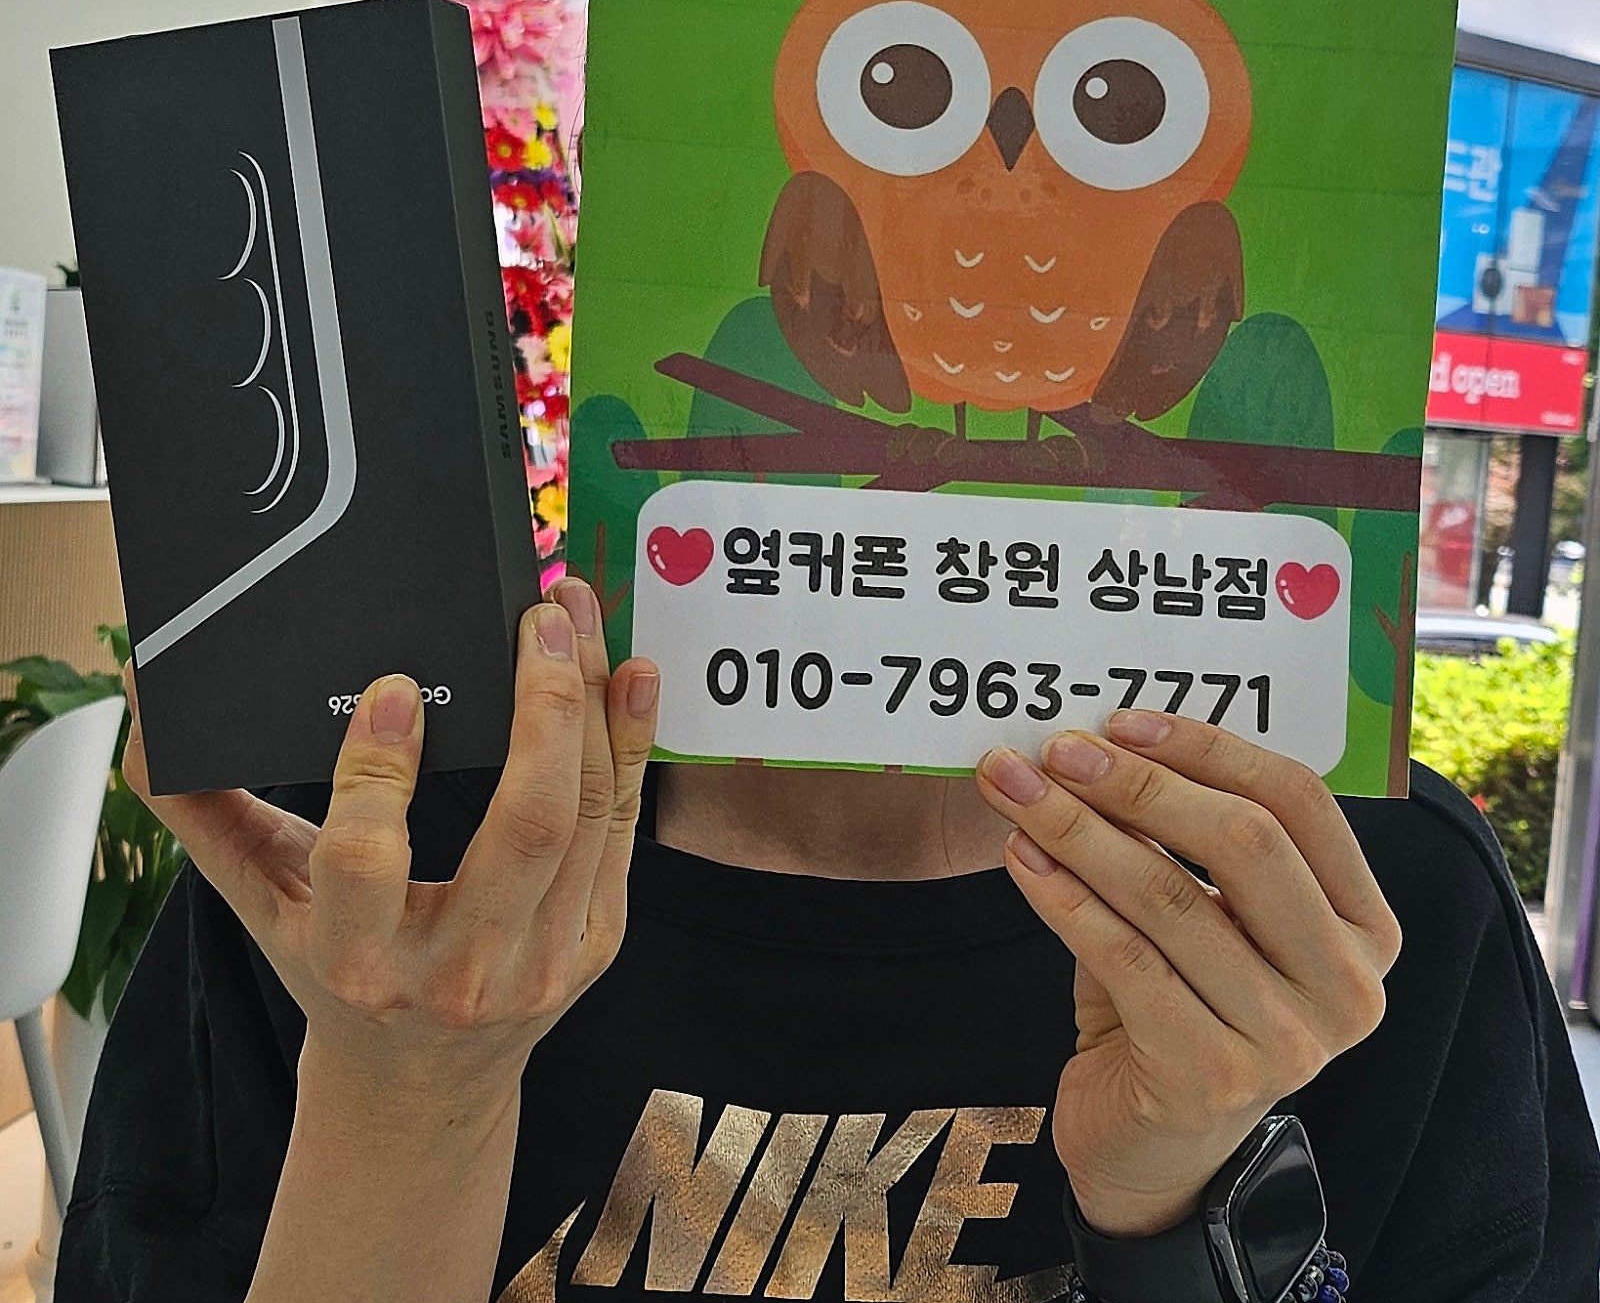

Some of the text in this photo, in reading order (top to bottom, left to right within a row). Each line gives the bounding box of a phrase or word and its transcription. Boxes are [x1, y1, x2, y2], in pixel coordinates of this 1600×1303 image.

[485, 310, 512, 459] SAMSUNG
[1451, 363, 1520, 405] open
[723, 526, 1268, 621] 옆커폰 창원 상남점
[706, 648, 1271, 734] 010-7963-7771
[571, 1089, 1047, 1303] NIKE
